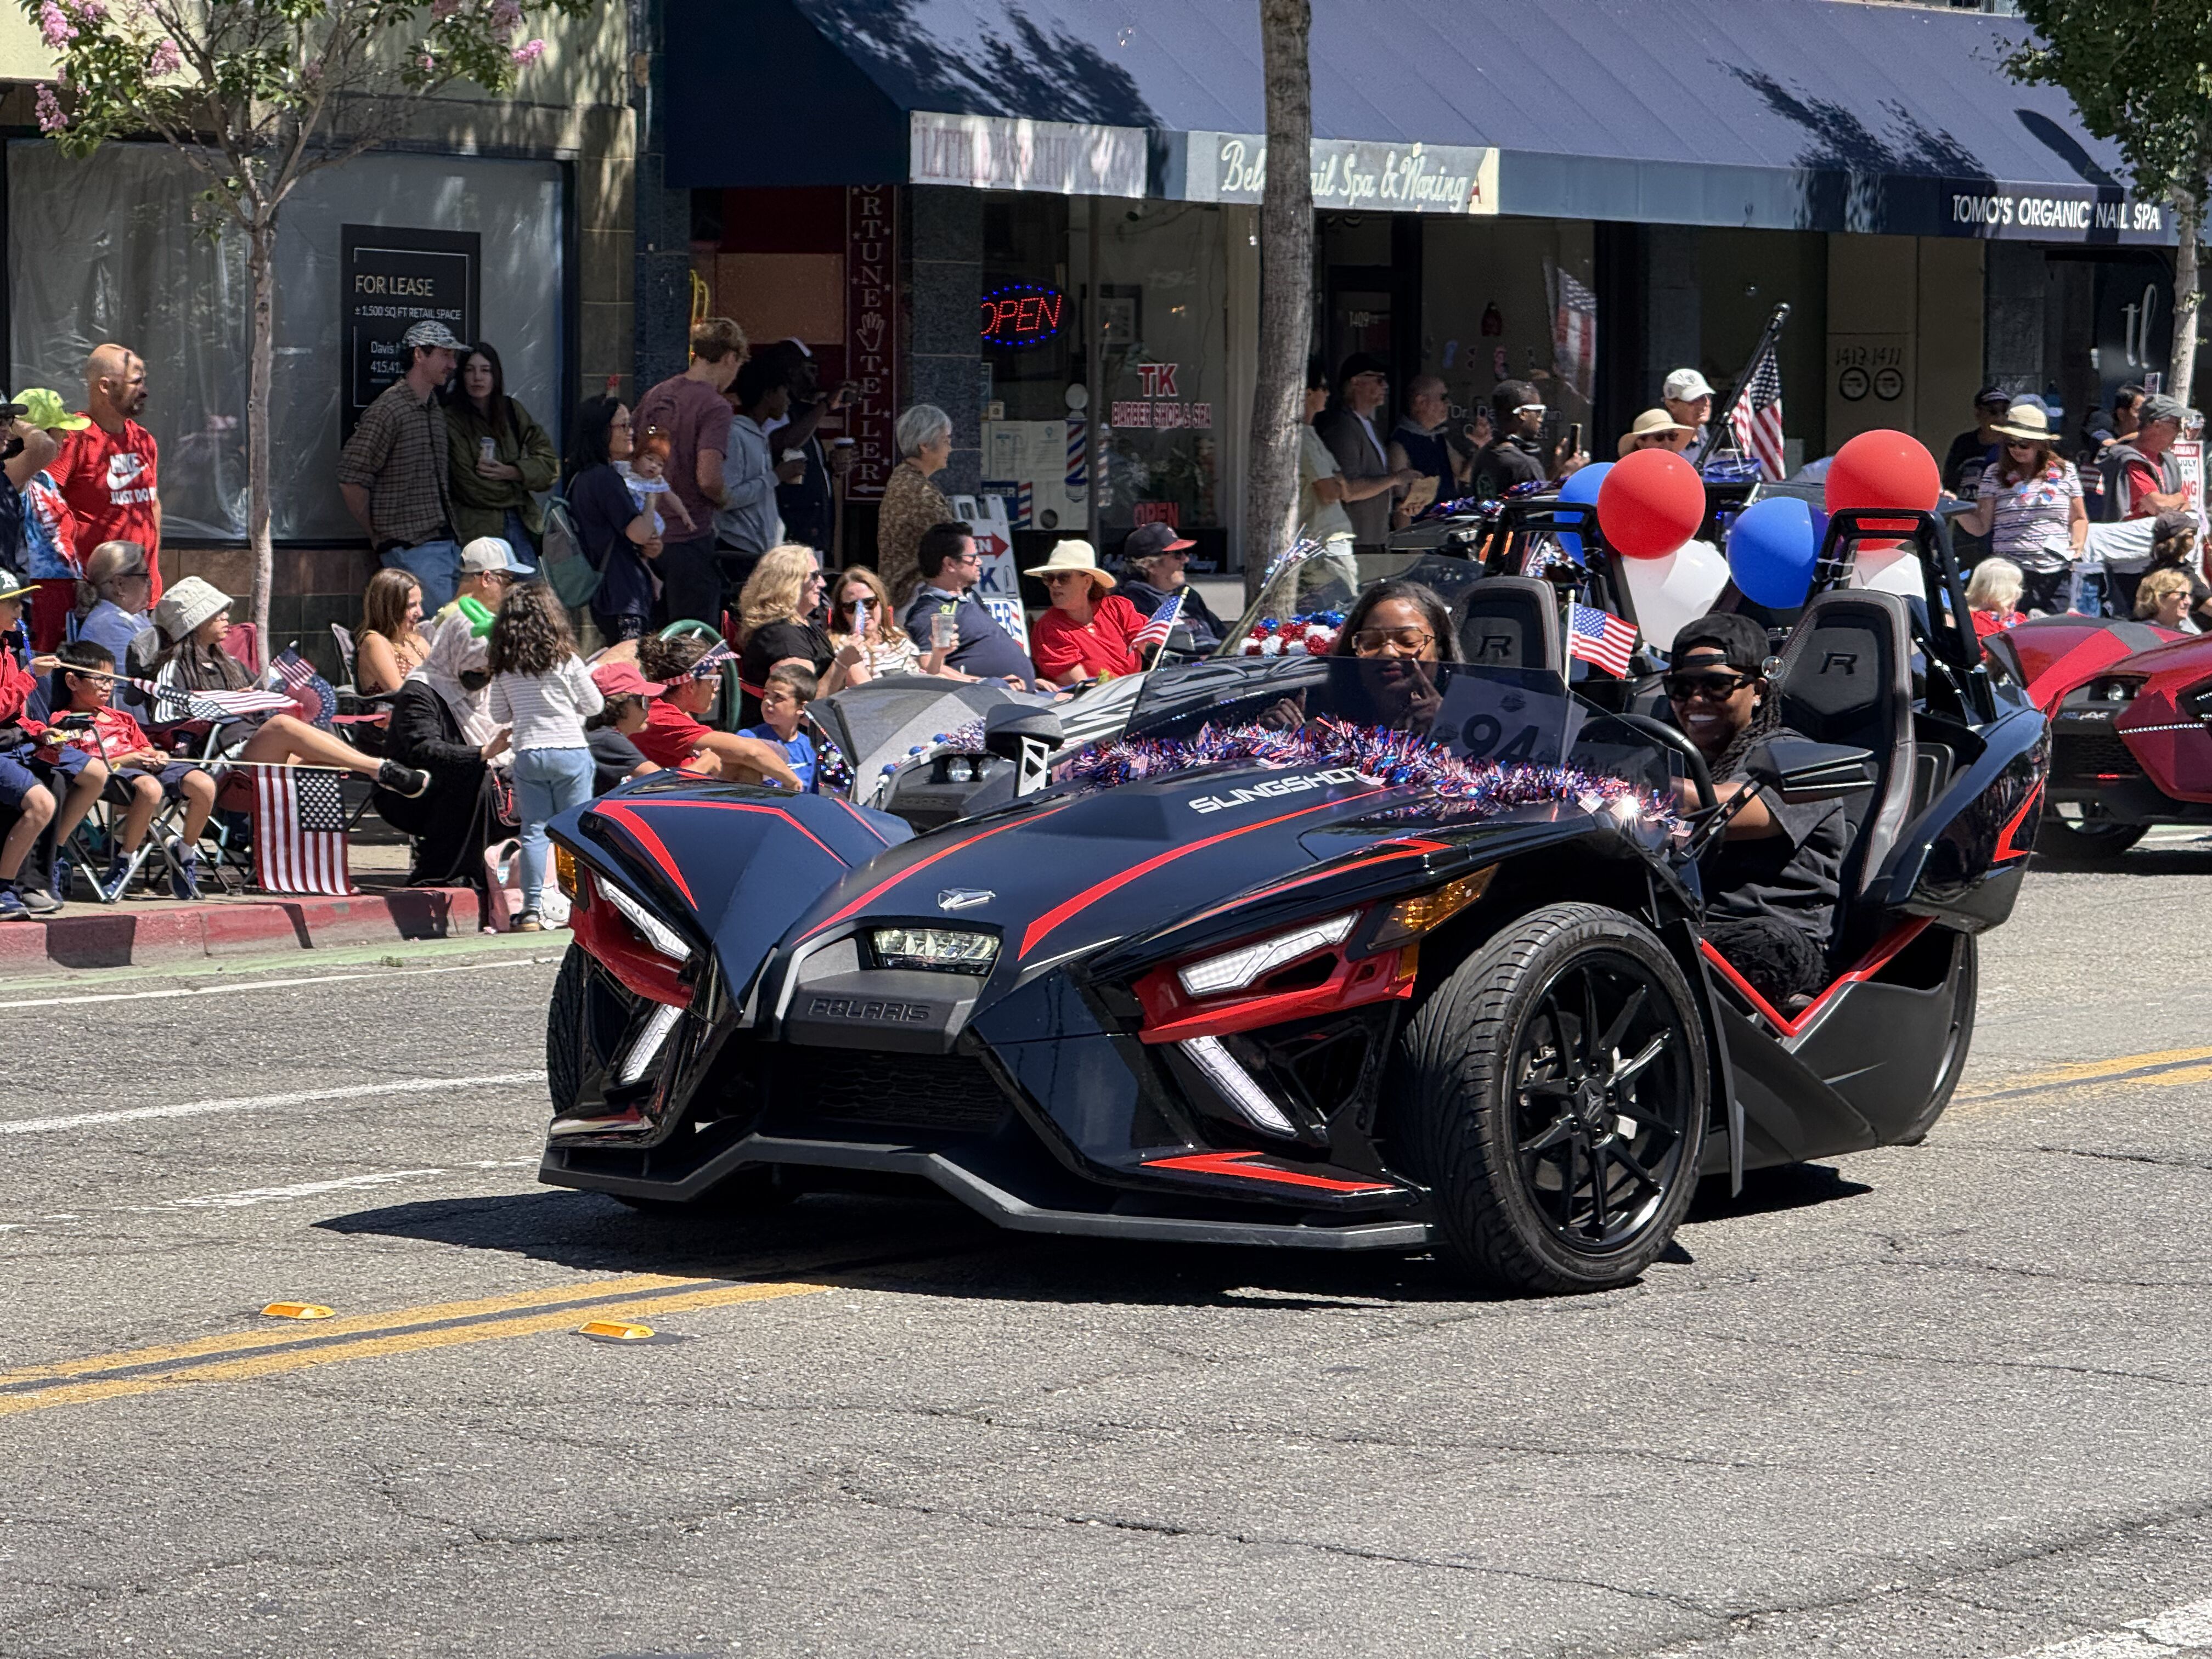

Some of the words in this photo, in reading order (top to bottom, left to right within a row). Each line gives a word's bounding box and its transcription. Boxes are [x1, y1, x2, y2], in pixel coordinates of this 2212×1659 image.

[1339, 153, 1376, 207] Spa
[1380, 151, 1399, 198] &
[1400, 155, 1469, 213] Waxing
[1953, 195, 2013, 224] TOMO'S
[2018, 197, 2091, 228] ORGANIC
[2096, 202, 2130, 229] NAIL
[2133, 202, 2162, 230] SPA
[355, 275, 386, 295] FOR
[390, 277, 435, 297] LEASE
[384, 307, 397, 319] SQ
[398, 307, 408, 318] FT
[409, 308, 436, 319] RETAIL
[436, 309, 461, 320] SPACE
[980, 294, 1063, 335] OPEN
[370, 341, 395, 354] Davis
[1137, 363, 1178, 397] TK
[860, 356, 883, 481] TELLER
[1111, 402, 1152, 428] BARBER
[1153, 402, 1181, 429] SHOP
[1192, 403, 1211, 429] SPA
[110, 489, 135, 505] JUST
[134, 487, 149, 503] DO
[1133, 502, 1179, 528] OPEN
[1477, 635, 1513, 657] R
[1820, 651, 1858, 675] R
[1462, 714, 1539, 764] 94
[1188, 766, 1359, 814] SLINGSHOT
[808, 998, 931, 1023] POLARIS
